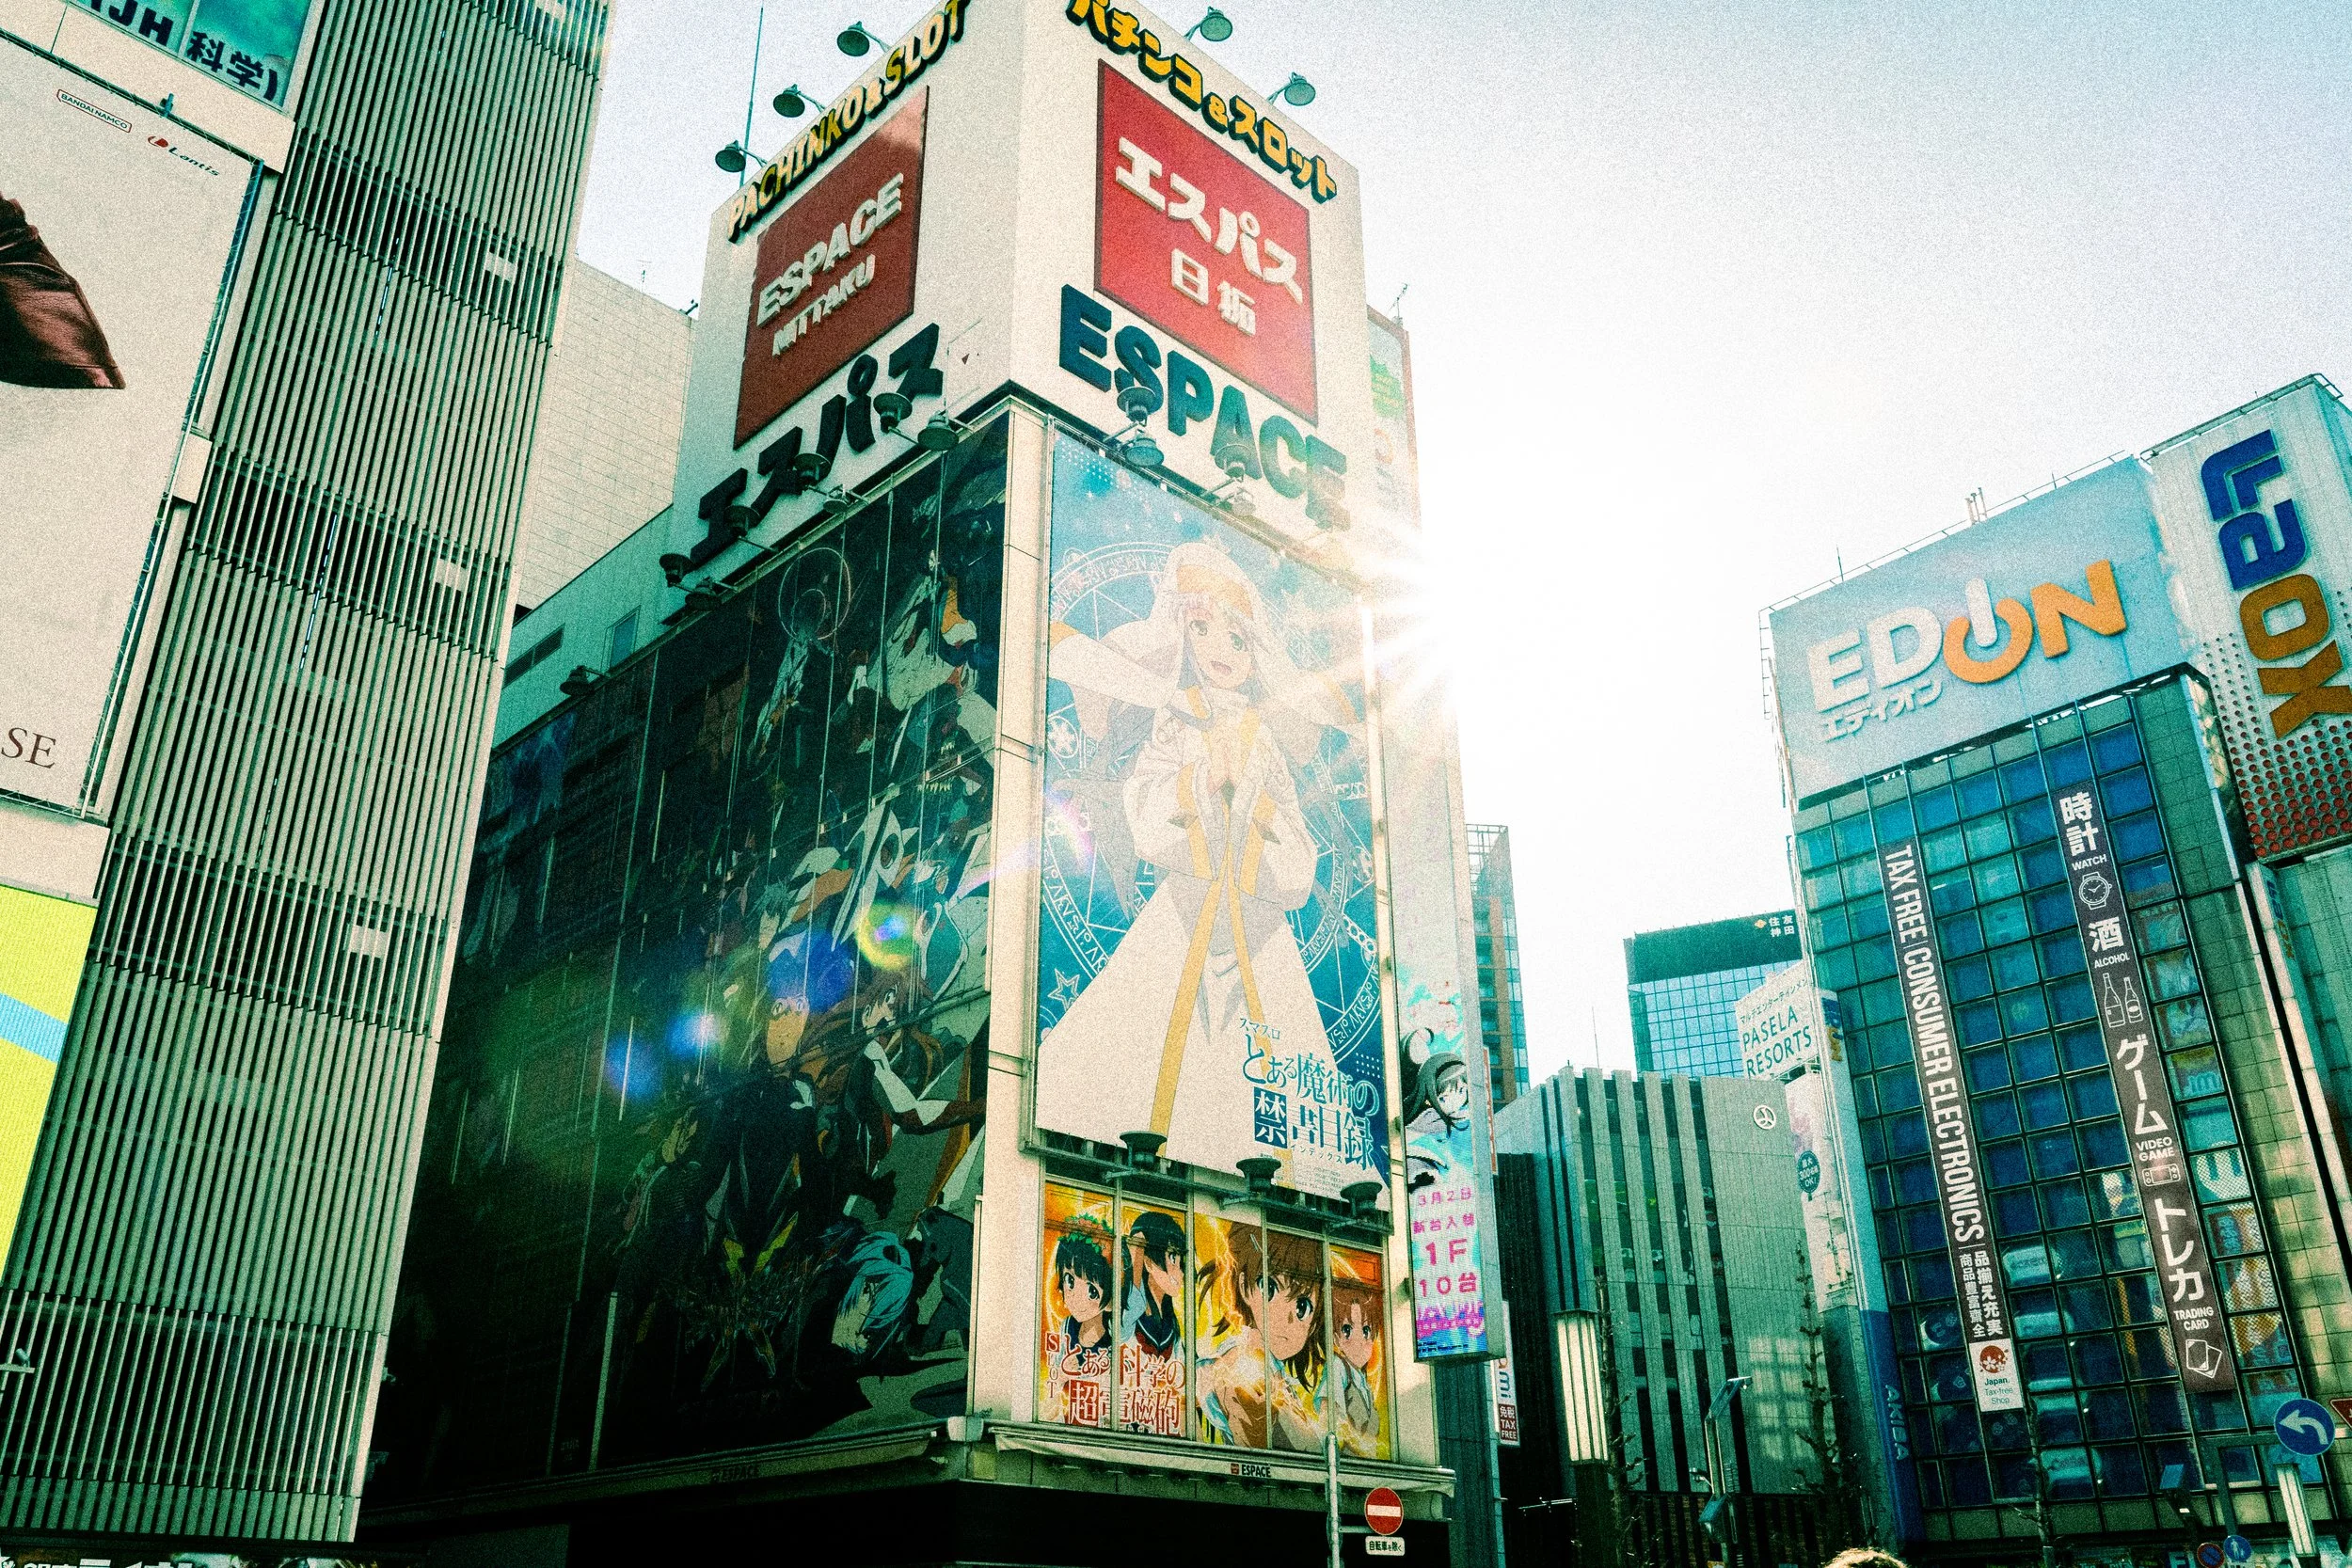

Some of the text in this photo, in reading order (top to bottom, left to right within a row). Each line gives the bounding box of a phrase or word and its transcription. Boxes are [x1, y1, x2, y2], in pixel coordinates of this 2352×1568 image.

[61, 93, 128, 130] BANDAI NAMCO
[168, 147, 220, 176] Lantis
[1115, 135, 1303, 305] エスパス
[756, 172, 904, 326] ESPACE
[1170, 247, 1256, 337] 日拓
[1058, 283, 1351, 531] ESPACE
[690, 323, 944, 569] エスパス
[1819, 678, 1944, 744] エディオン
[2059, 791, 2099, 857] 時計
[2072, 854, 2107, 871] WATCH
[2089, 916, 2125, 953] 酒
[2094, 952, 2130, 969] ALCOHOL
[1742, 1005, 1799, 1053] PASELA
[1885, 845, 1985, 1243] TAX FREE CONSUMER ELECTRONICS
[1746, 1025, 1812, 1079] RESORTS
[2117, 1033, 2169, 1134] ゲーム
[2136, 1135, 2173, 1152] VIDEO
[2138, 1147, 2175, 1162] GAME
[2154, 1197, 2205, 1303] トレカ
[2173, 1307, 2215, 1322] TRADING
[2183, 1319, 2209, 1331] CARD
[1985, 1386, 2014, 1397] Tax-free
[1991, 1395, 2010, 1405] Shop
[1501, 1418, 1516, 1430] TAX
[1502, 1430, 1518, 1440] FREE
[1242, 1464, 1271, 1478] ESPACE
